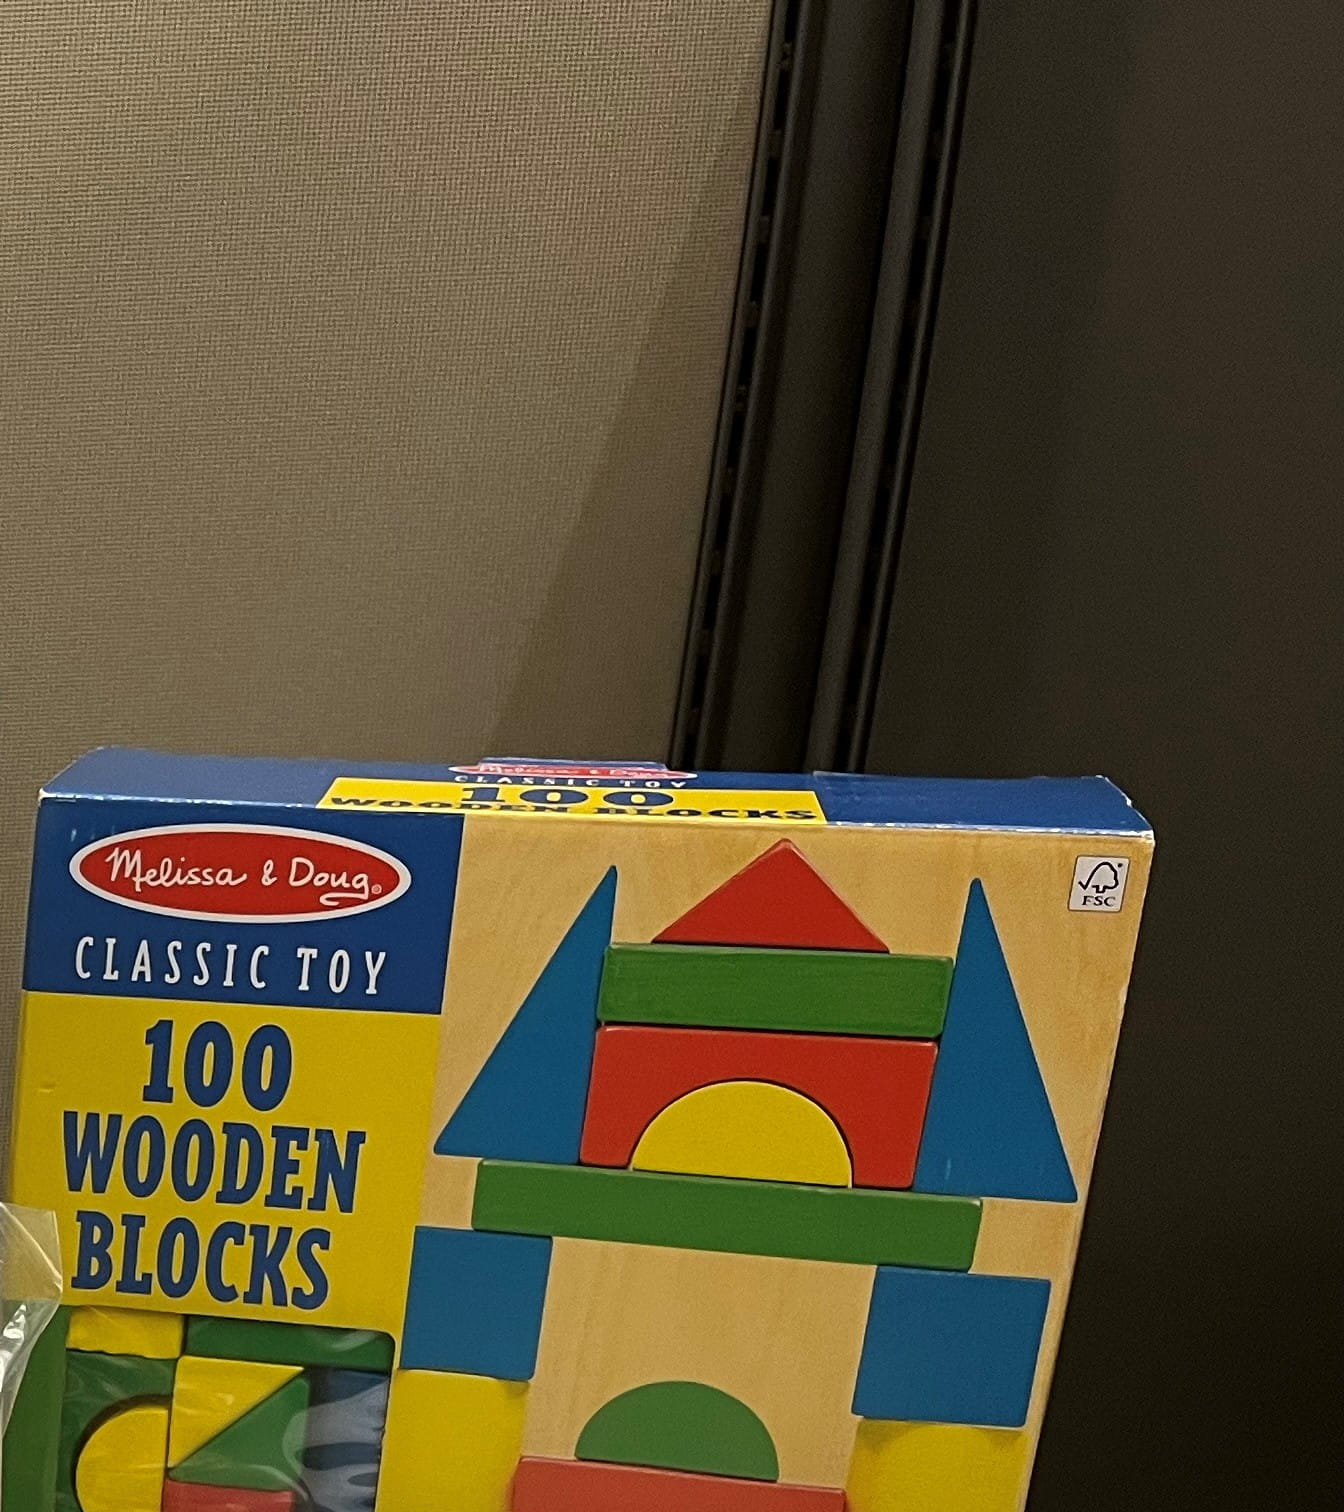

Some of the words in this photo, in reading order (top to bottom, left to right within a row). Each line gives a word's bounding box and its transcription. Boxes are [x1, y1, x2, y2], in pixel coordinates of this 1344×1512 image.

[330, 798, 574, 814] WOODEN
[596, 807, 817, 820] BLOCKS
[454, 775, 600, 787] CLASSIC
[619, 779, 687, 789] TOY
[461, 787, 675, 806] 100
[105, 847, 248, 892] Melissa
[261, 859, 278, 886] &
[288, 856, 371, 906] Doug
[1081, 895, 1116, 907] FSC
[75, 936, 270, 989] CLASSIC
[296, 946, 387, 995] TOY
[141, 1018, 293, 1113] 100
[62, 1110, 367, 1215] WOODEN
[70, 1210, 332, 1310] BLOCKS
